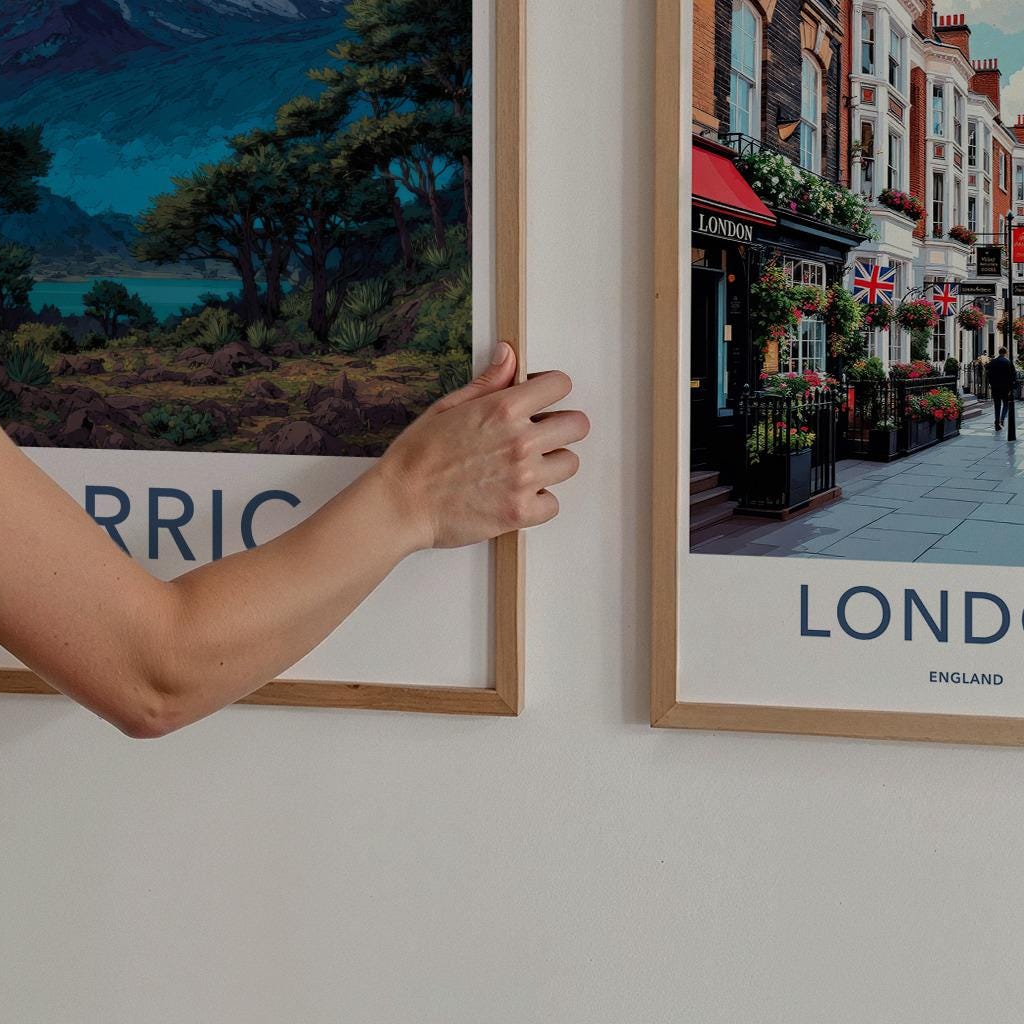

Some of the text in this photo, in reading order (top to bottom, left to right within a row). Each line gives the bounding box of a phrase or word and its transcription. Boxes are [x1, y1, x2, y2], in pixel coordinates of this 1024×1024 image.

[698, 213, 753, 242] LONDON
[800, 584, 1024, 645] LOND
[929, 671, 1004, 686] ENGLAND
